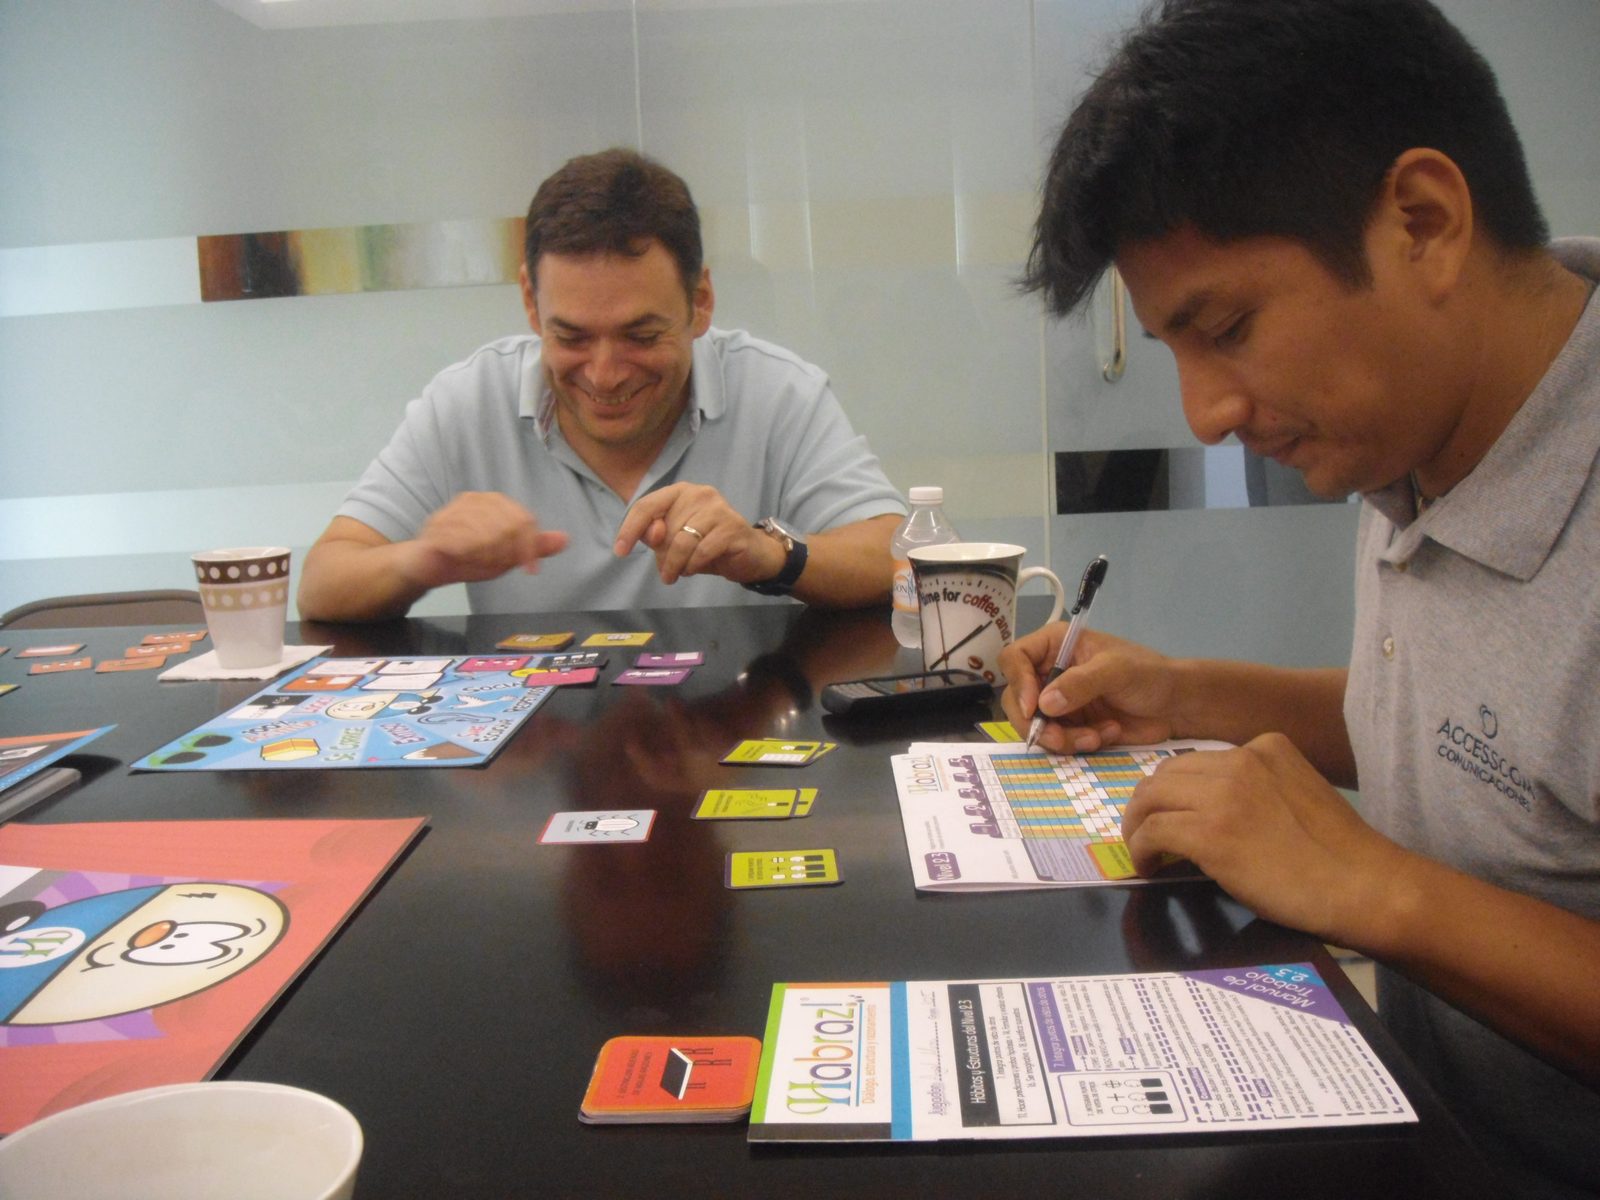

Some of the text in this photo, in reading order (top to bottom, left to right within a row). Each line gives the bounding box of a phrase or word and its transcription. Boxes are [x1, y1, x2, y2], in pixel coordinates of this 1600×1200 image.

[943, 587, 961, 602] for
[962, 593, 1000, 618] coffee
[995, 615, 1012, 641] and
[936, 863, 955, 880] Nivel
[1245, 971, 1313, 997] Trabajo
[1274, 967, 1309, 982] 2.3
[1222, 974, 1315, 1008] Manual de
[957, 999, 973, 1009] 2.3
[958, 1009, 975, 1024] Nivel
[960, 1024, 977, 1034] del
[784, 1000, 858, 1115] Habraz!
[965, 1035, 982, 1069] Estructuras
